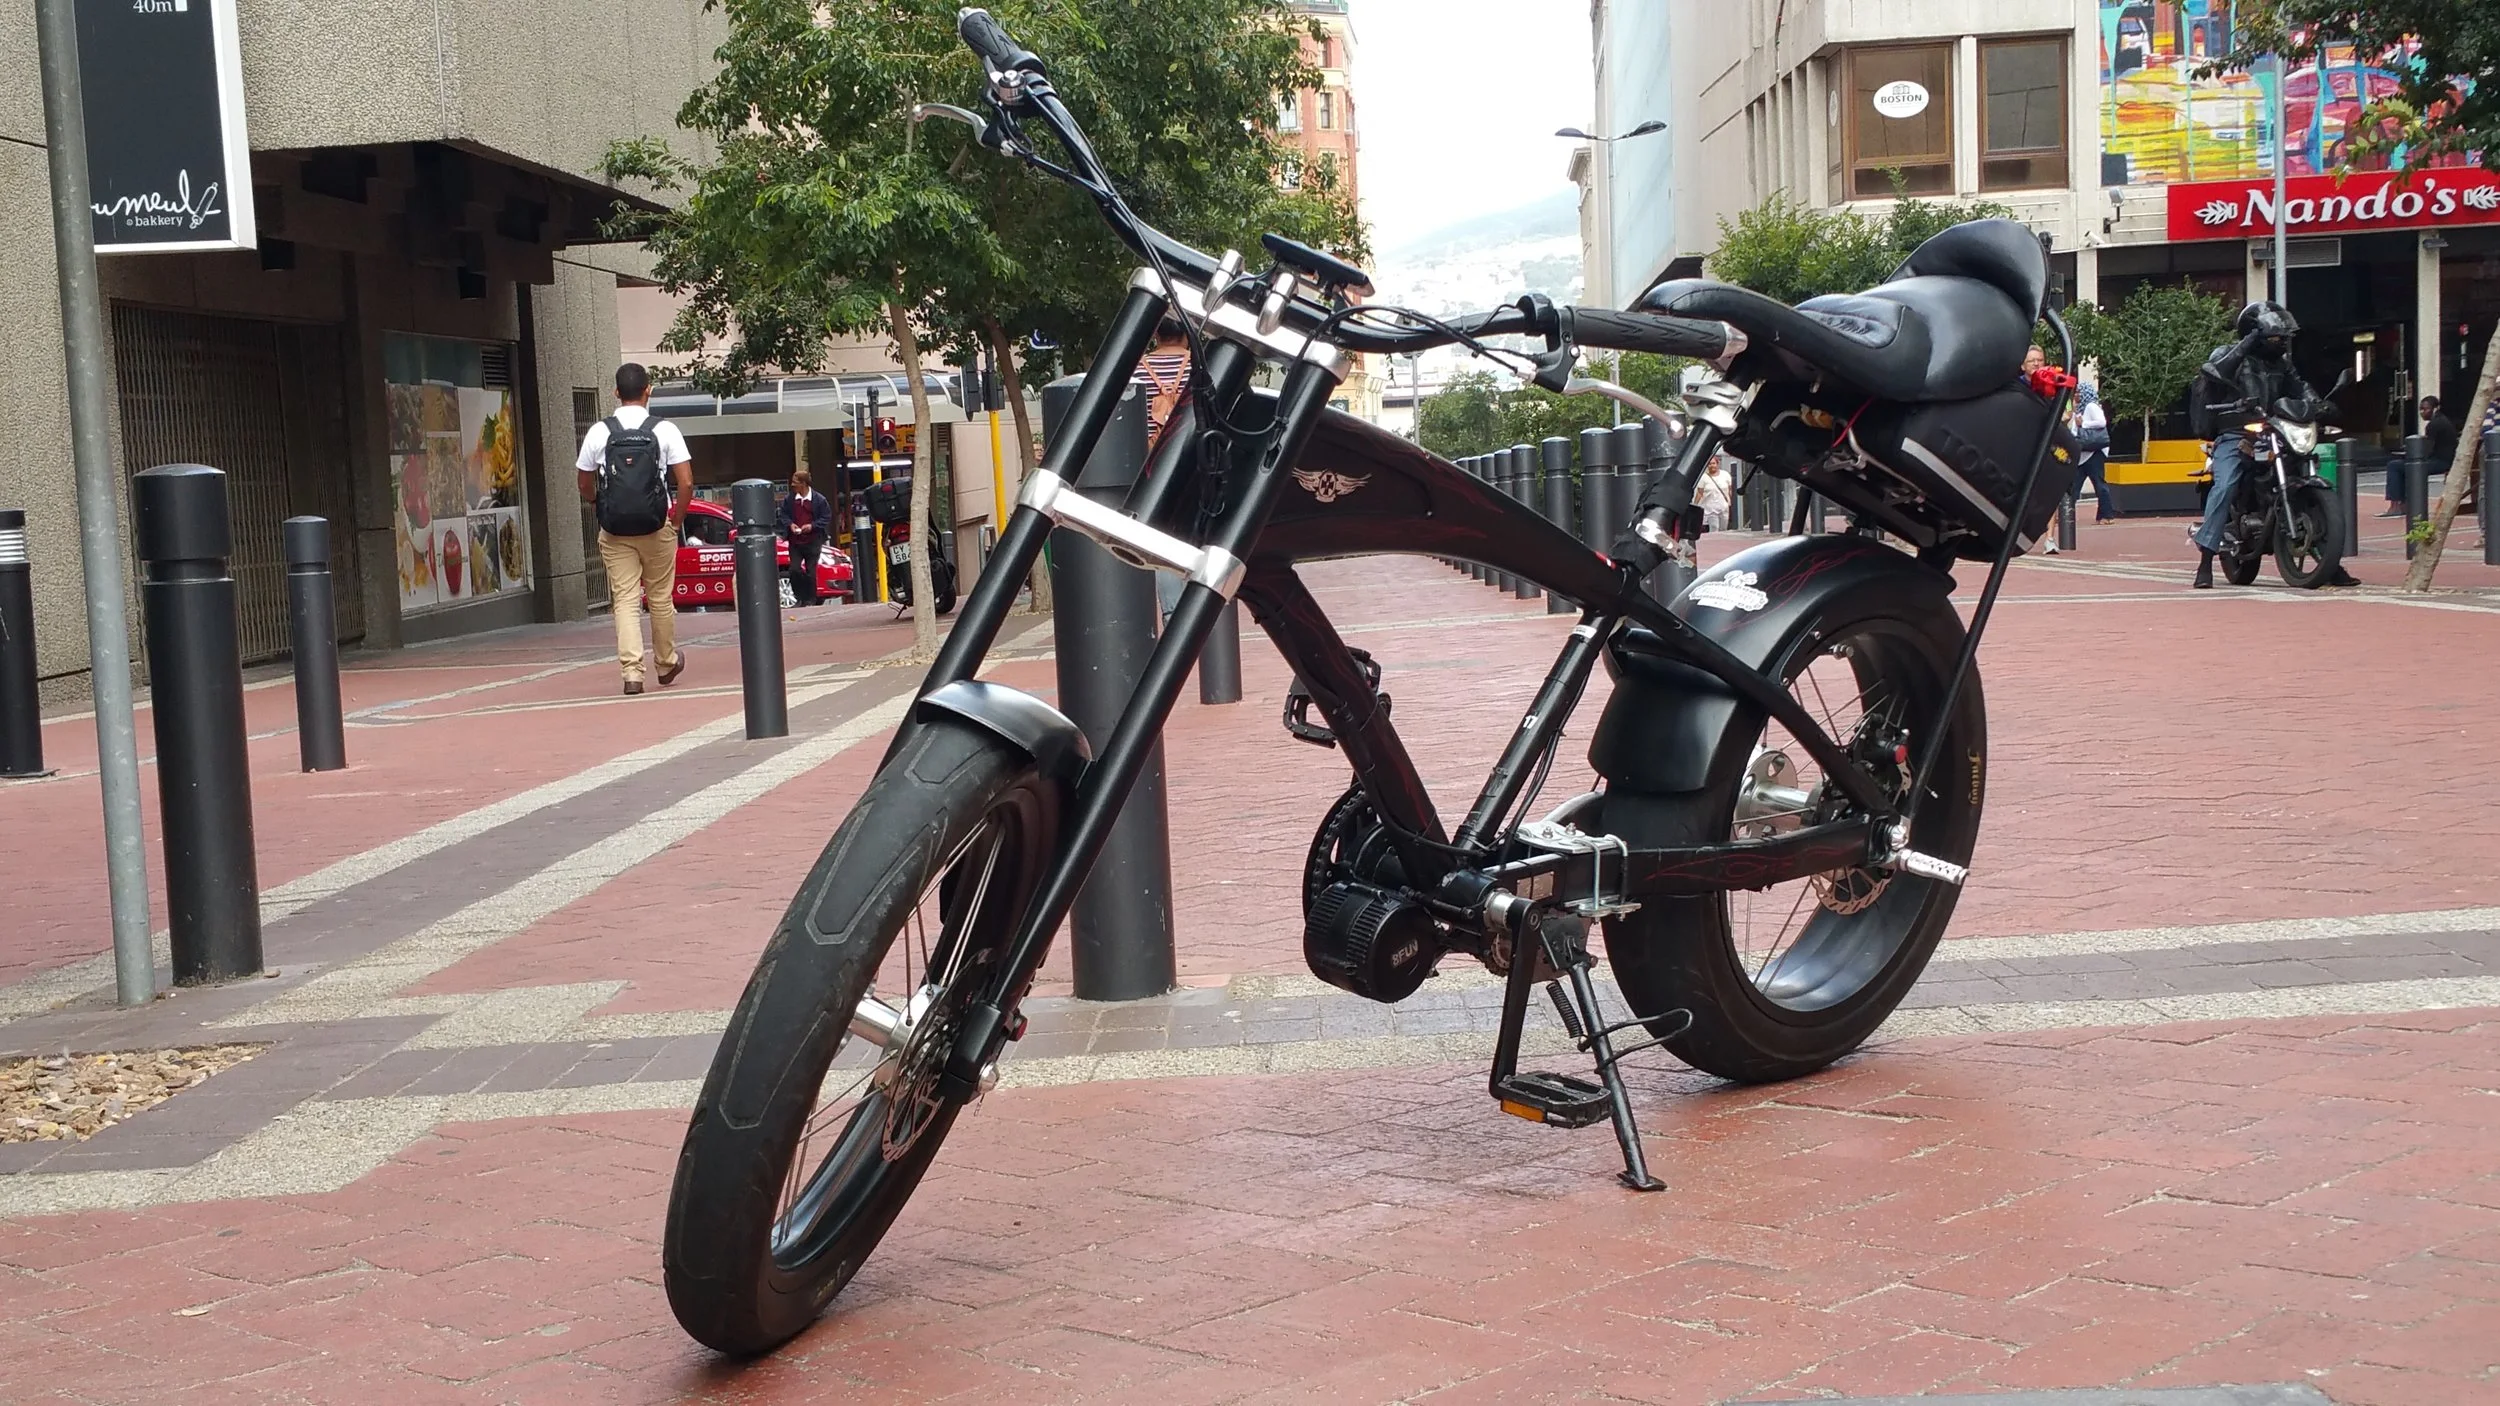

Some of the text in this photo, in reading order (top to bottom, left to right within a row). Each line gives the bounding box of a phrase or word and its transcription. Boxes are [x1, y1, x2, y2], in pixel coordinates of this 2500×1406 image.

[133, 0, 172, 13] 40m
[1880, 94, 1922, 104] BOSTON
[2240, 178, 2457, 227] Nando's
[135, 215, 183, 228] bakkery
[699, 553, 734, 562] SPORT
